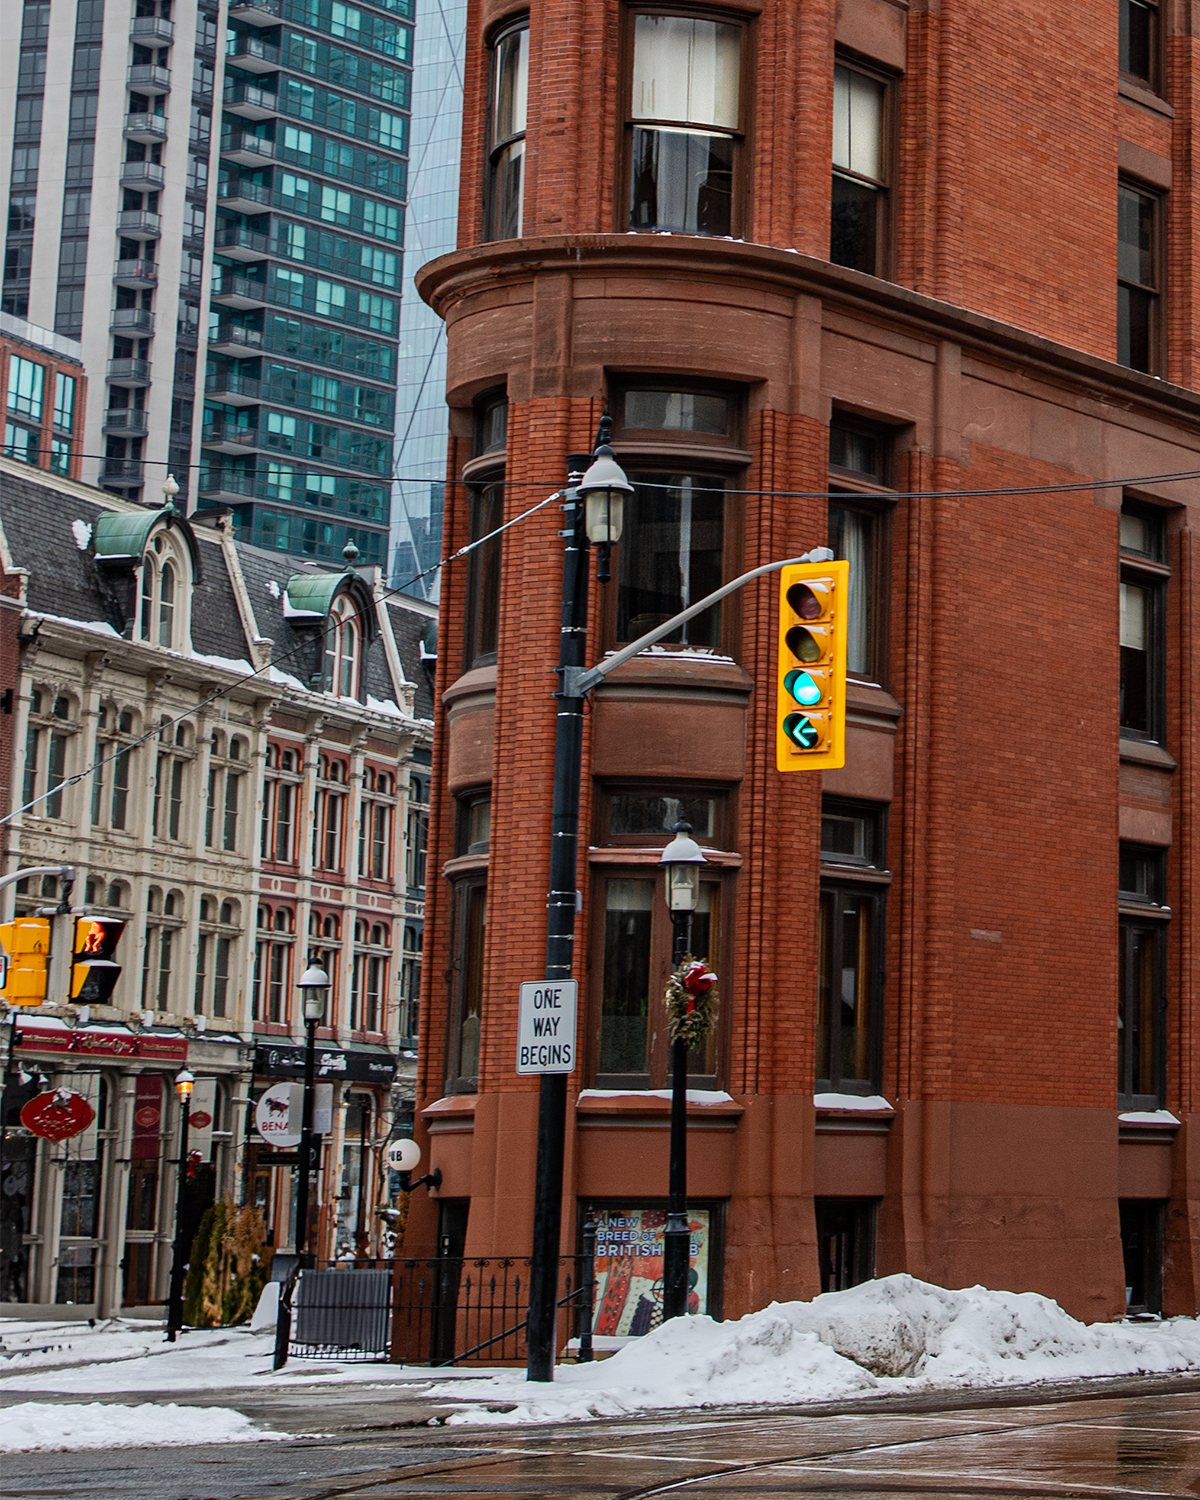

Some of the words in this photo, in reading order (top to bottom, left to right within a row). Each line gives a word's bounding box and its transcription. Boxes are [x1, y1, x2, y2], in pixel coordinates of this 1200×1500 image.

[533, 988, 562, 1009] ONE
[533, 1016, 561, 1037] WAY
[520, 1044, 571, 1066] BEGINS
[597, 1220, 605, 1228] A
[608, 1217, 639, 1228] NEW
[597, 1231, 639, 1241] BREED
[641, 1232, 656, 1240] OF
[597, 1244, 663, 1257] BRITISH
